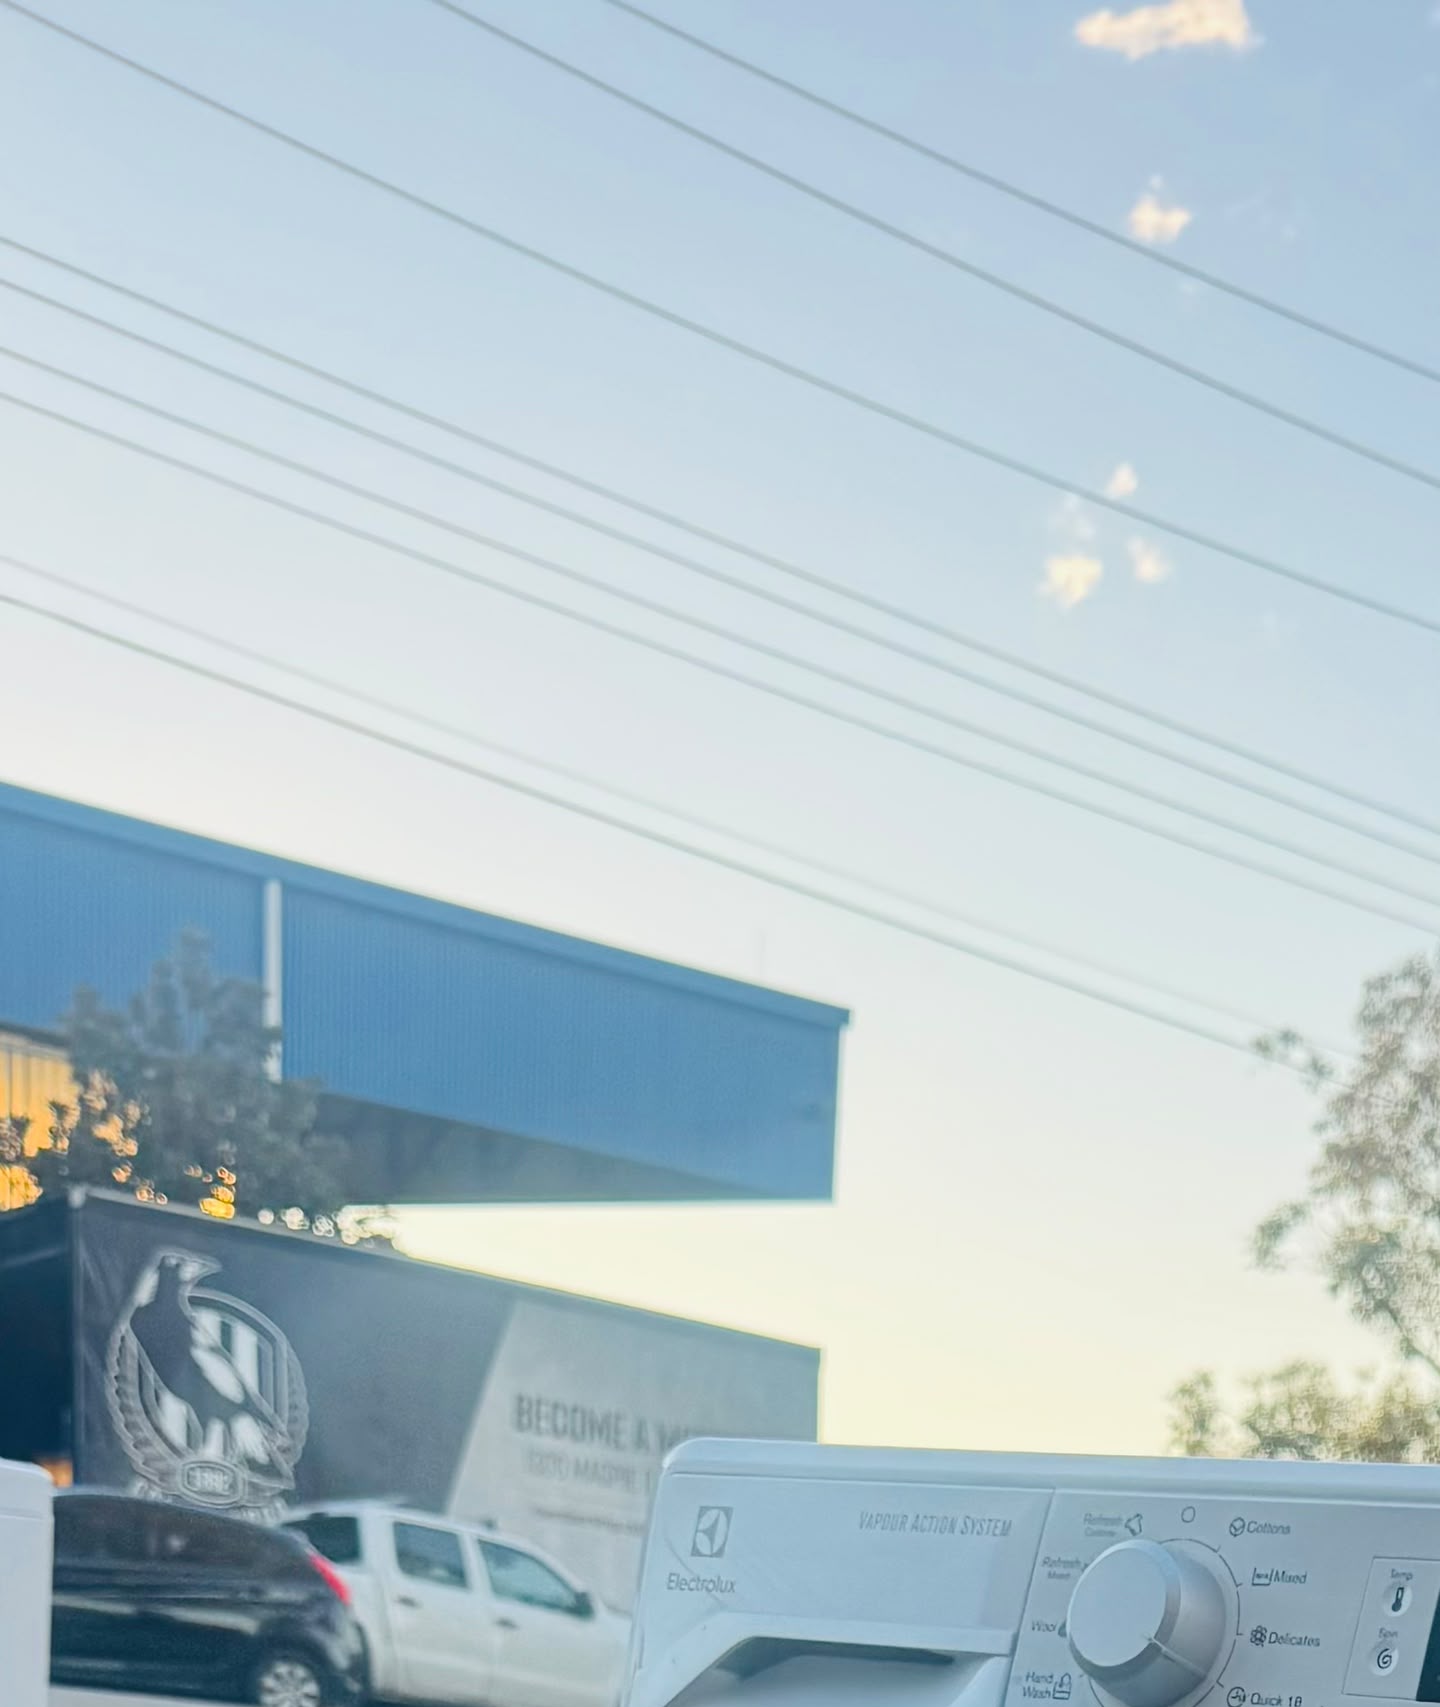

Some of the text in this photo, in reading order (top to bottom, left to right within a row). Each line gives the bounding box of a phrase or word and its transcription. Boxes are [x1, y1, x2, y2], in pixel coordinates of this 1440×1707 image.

[516, 1394, 628, 1452] BECOME
[859, 1510, 1012, 1536] VAPOUR ACTION SYSTEM
[1246, 1520, 1291, 1535] Cottons
[666, 1572, 737, 1594] Electrolux
[1268, 1631, 1320, 1647] Delicates
[1025, 1672, 1054, 1684] Hand
[1022, 1686, 1050, 1699] Wash
[1250, 1692, 1283, 1707] Quick
